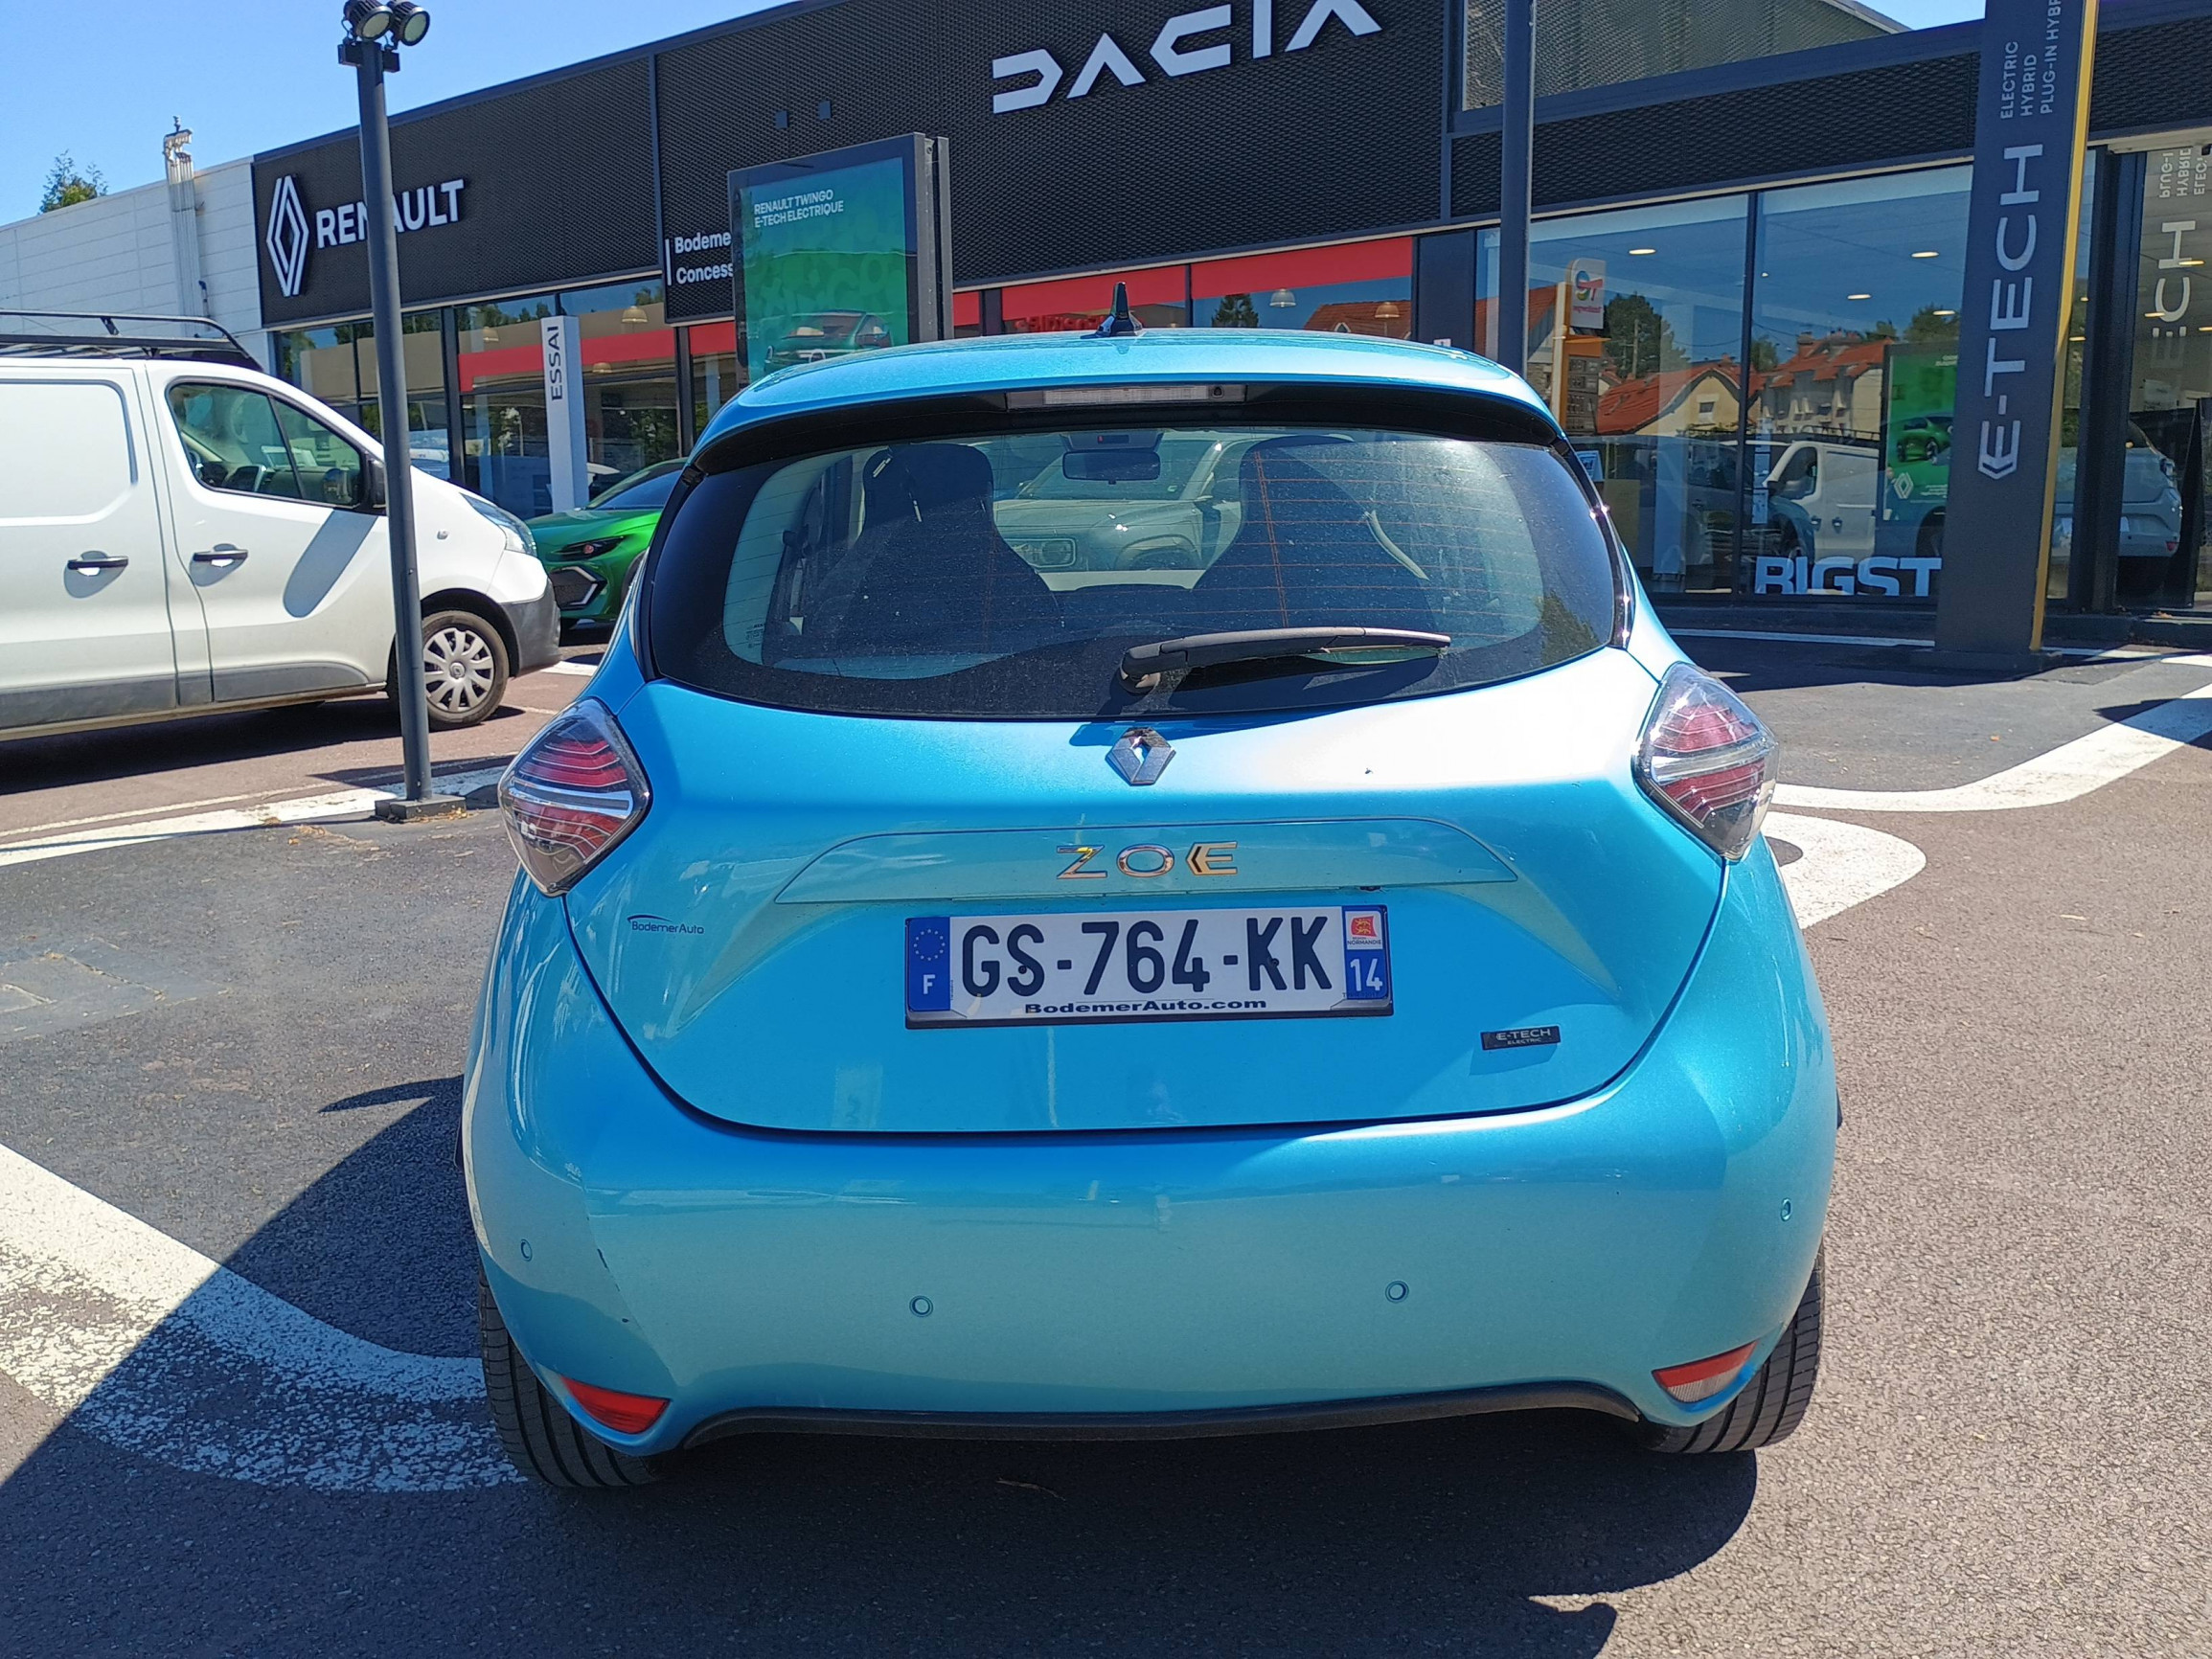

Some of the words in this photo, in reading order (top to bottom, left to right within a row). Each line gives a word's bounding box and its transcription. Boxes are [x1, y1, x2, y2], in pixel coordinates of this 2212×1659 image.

[992, 0, 1382, 114] DACIA
[2000, 41, 2018, 119] ELECTRIC
[2019, 55, 2037, 116] HYBRID
[2041, 45, 2058, 114] PLUG-IN
[754, 197, 794, 216] RENAULT
[794, 190, 833, 207] TWINGO
[754, 212, 787, 228] E-TECH
[787, 200, 844, 222] ELECTRIQUE
[674, 232, 732, 254] Bodeme
[1978, 144, 2043, 479] E-TECH
[547, 326, 563, 400] ESSAI
[1057, 841, 1238, 879] ZOE
[632, 920, 704, 934] BodemerAuto
[962, 917, 1333, 997] GS-764-KK
[923, 974, 936, 994] F
[1350, 959, 1382, 991] 14
[1025, 999, 1266, 1014] BodemerAuto.com
[1496, 1029, 1551, 1040] E-TECH
